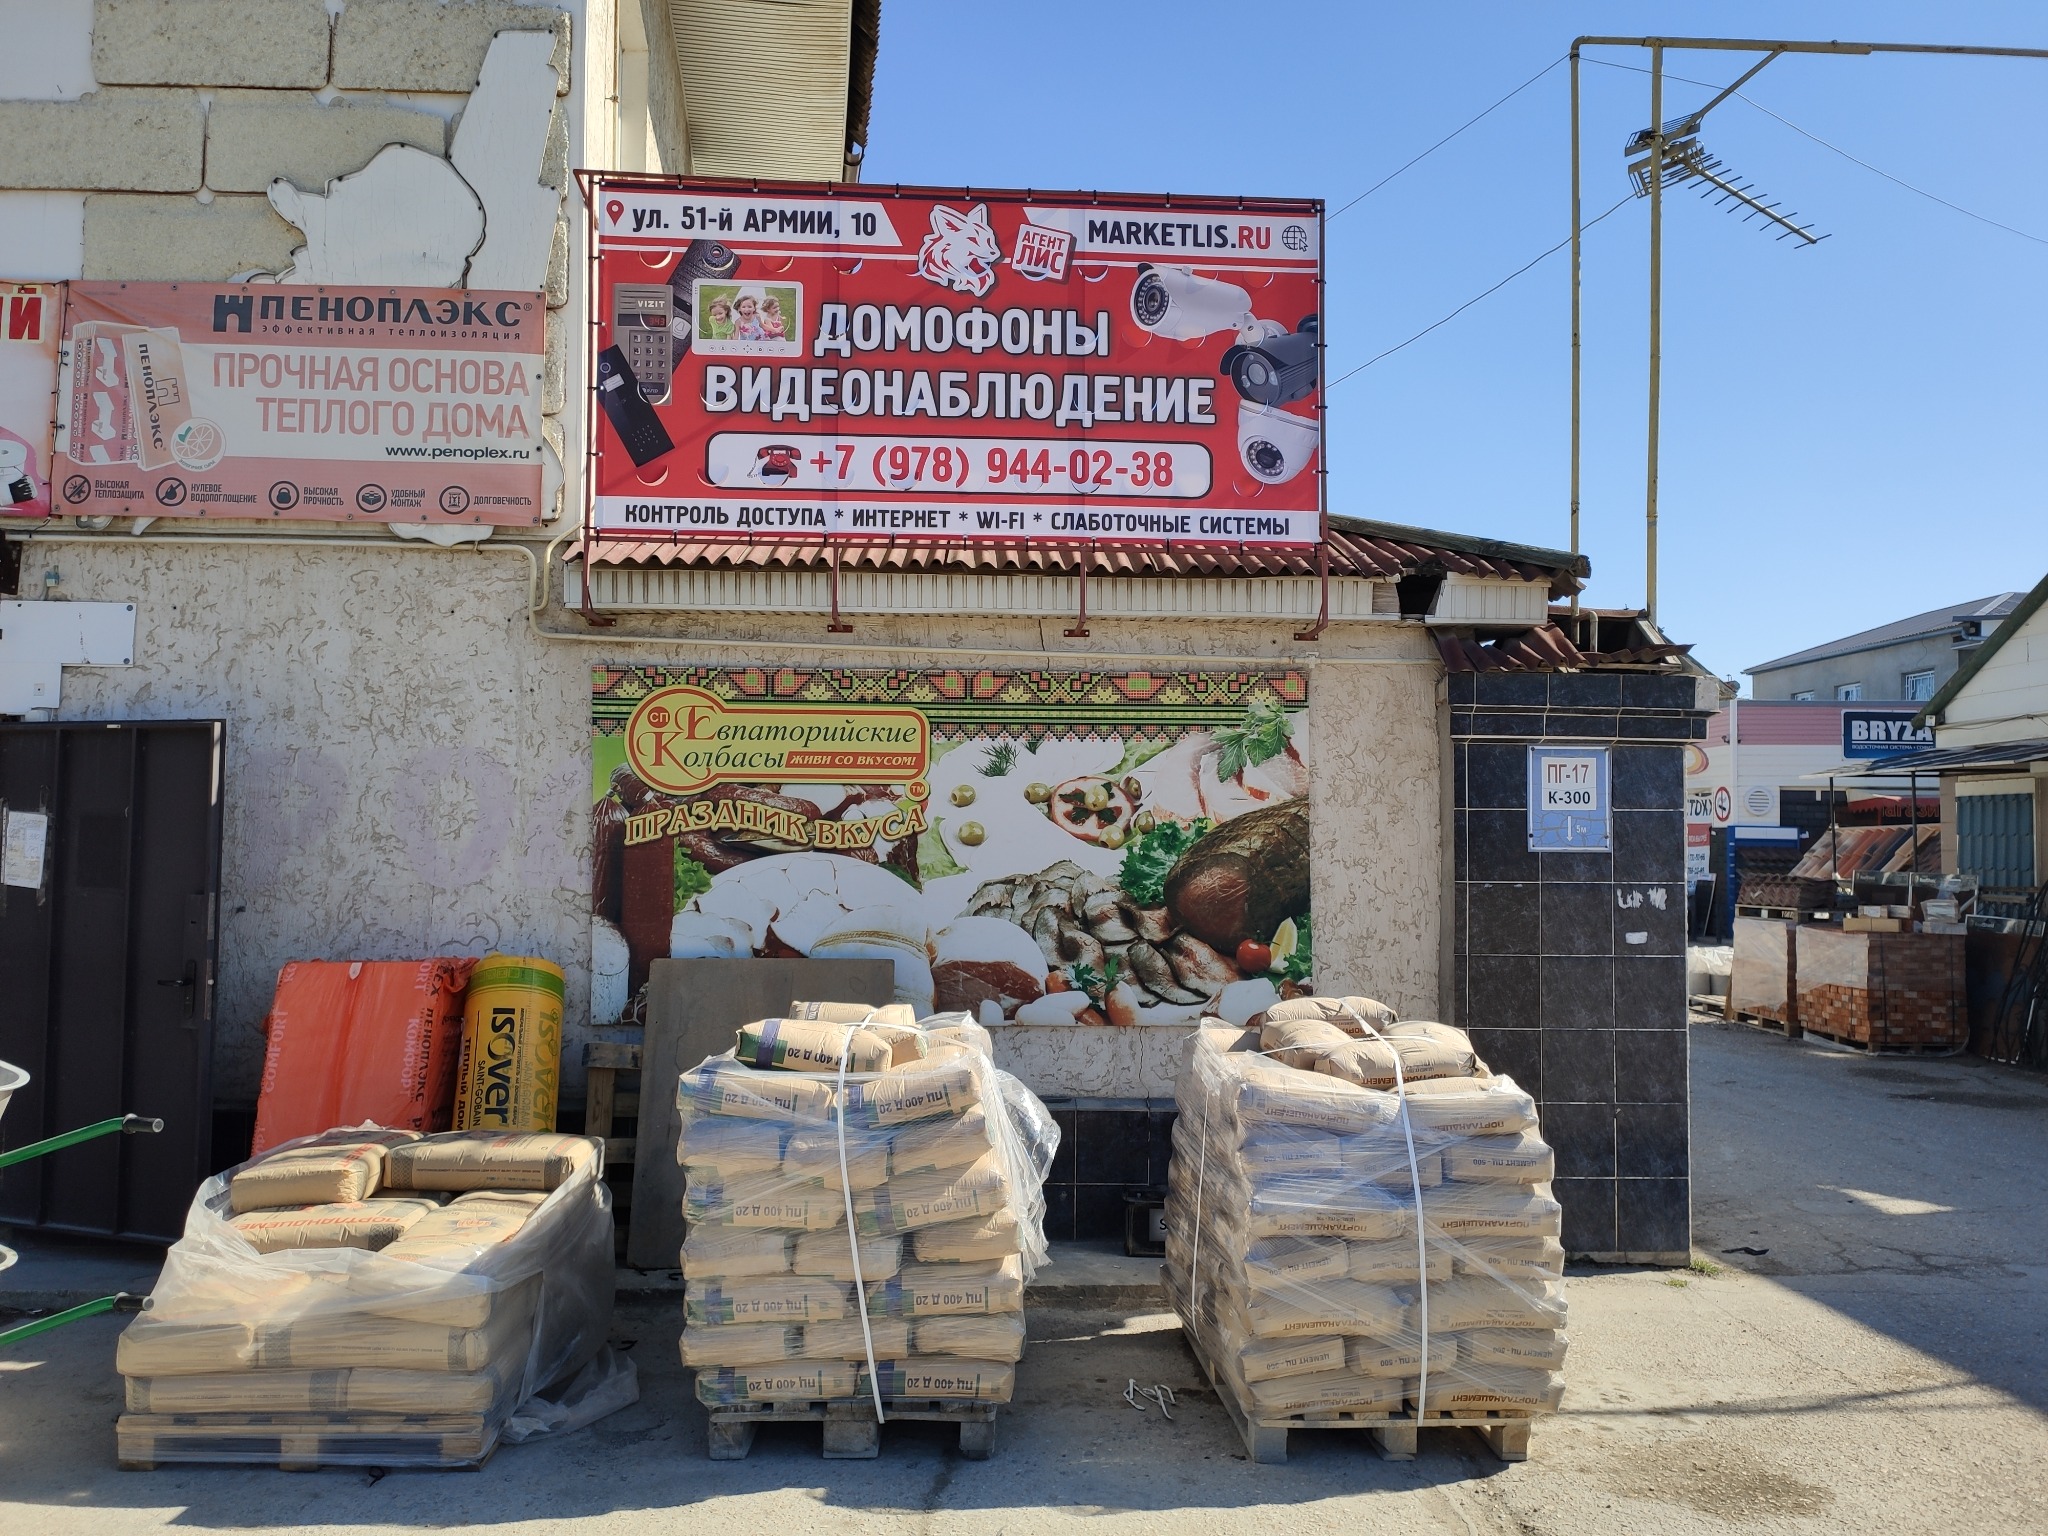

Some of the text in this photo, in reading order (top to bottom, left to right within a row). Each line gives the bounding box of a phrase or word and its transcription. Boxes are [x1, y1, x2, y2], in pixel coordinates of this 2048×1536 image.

[632, 205, 877, 239] ул. 51-й АРМИИ, 10
[1022, 230, 1065, 250] АГЕНТ
[1088, 219, 1271, 250] MARKETLIS.RU
[1016, 244, 1063, 273] ЛИС
[637, 300, 666, 308] VIZIT
[260, 295, 521, 327] ПЕНОПЛЭКС
[262, 324, 521, 341] эффективная теплоизоляция
[814, 303, 1109, 358] ДОМОФОНЫ
[213, 352, 530, 397] ПРОЧНАЯ ОСНОВА
[704, 366, 1216, 427] ВИДЕОНАБЛЮДЕНИЕ
[256, 396, 530, 444] ТЕПЛОГО ДОМА
[386, 446, 530, 460] www.penoplex.ru
[810, 444, 1175, 488] +7 (978) 944-02-38
[95, 479, 129, 489] ВЫСОКАЯ
[190, 483, 222, 493] НУЛЕВОЕ
[94, 489, 145, 500] ТЕПЛОЗАЩИТА
[303, 486, 338, 496] ВЫСОКАЯ
[390, 488, 426, 499] УДОБНЫЙ
[190, 493, 257, 504] ВОДОПОГЛОЩЕНИЕ
[303, 496, 345, 506] ПРОЧНОСТЬ
[390, 498, 422, 508] МОНТАЖ
[473, 495, 532, 506] ДОЛГОВЕЧНОСТЬ
[625, 505, 1290, 536] КОНТРОЛЬ ДОСТУПА ИНТЕРНЕТ WI-FI СЛАБОТОЧНЫЕ СИСТЕМЫ
[650, 712, 669, 723] СП
[675, 705, 917, 748] Евпаторийские
[636, 731, 784, 780] Колбасы
[790, 755, 916, 766] ЖИВИ СО ВКУСОМ!
[1547, 764, 1589, 784] ПГ-17
[1548, 791, 1591, 804] К-300
[628, 803, 925, 845] ПРАЗДНИК ВКУСА
[265, 1010, 288, 1093] COMFORT
[415, 1007, 434, 1102] ПЕНОПЛЭКС
[787, 1047, 800, 1058] 20
[402, 1018, 419, 1098] КОМФОРТ
[459, 1036, 472, 1095] ТЕПЛЫЙ
[472, 1060, 486, 1126] SAINT-GOBAIN
[724, 1093, 738, 1102] 20
[926, 1091, 943, 1103] ПЦ
[880, 1102, 892, 1114] 20
[905, 1097, 924, 1108] 400
[735, 1206, 749, 1216] 20
[763, 1207, 783, 1217] 400
[906, 1208, 920, 1218] 20
[1441, 1220, 1530, 1229] ПОРТЛАНДЦЕМЕНТ
[915, 1292, 982, 1306] ПЦ 400 Д 20
[735, 1303, 749, 1313] 20
[763, 1302, 783, 1312] 400
[1283, 1319, 1371, 1331] ПОРТЛАНДЦЕМЕНТ
[748, 1381, 762, 1391] 20
[764, 1379, 773, 1390] Д
[776, 1378, 796, 1389] 400
[907, 1376, 973, 1390] ПЦ 400 Д 20
[1451, 1394, 1538, 1405] ПОРТЛАНДЦЕМЕНТ
